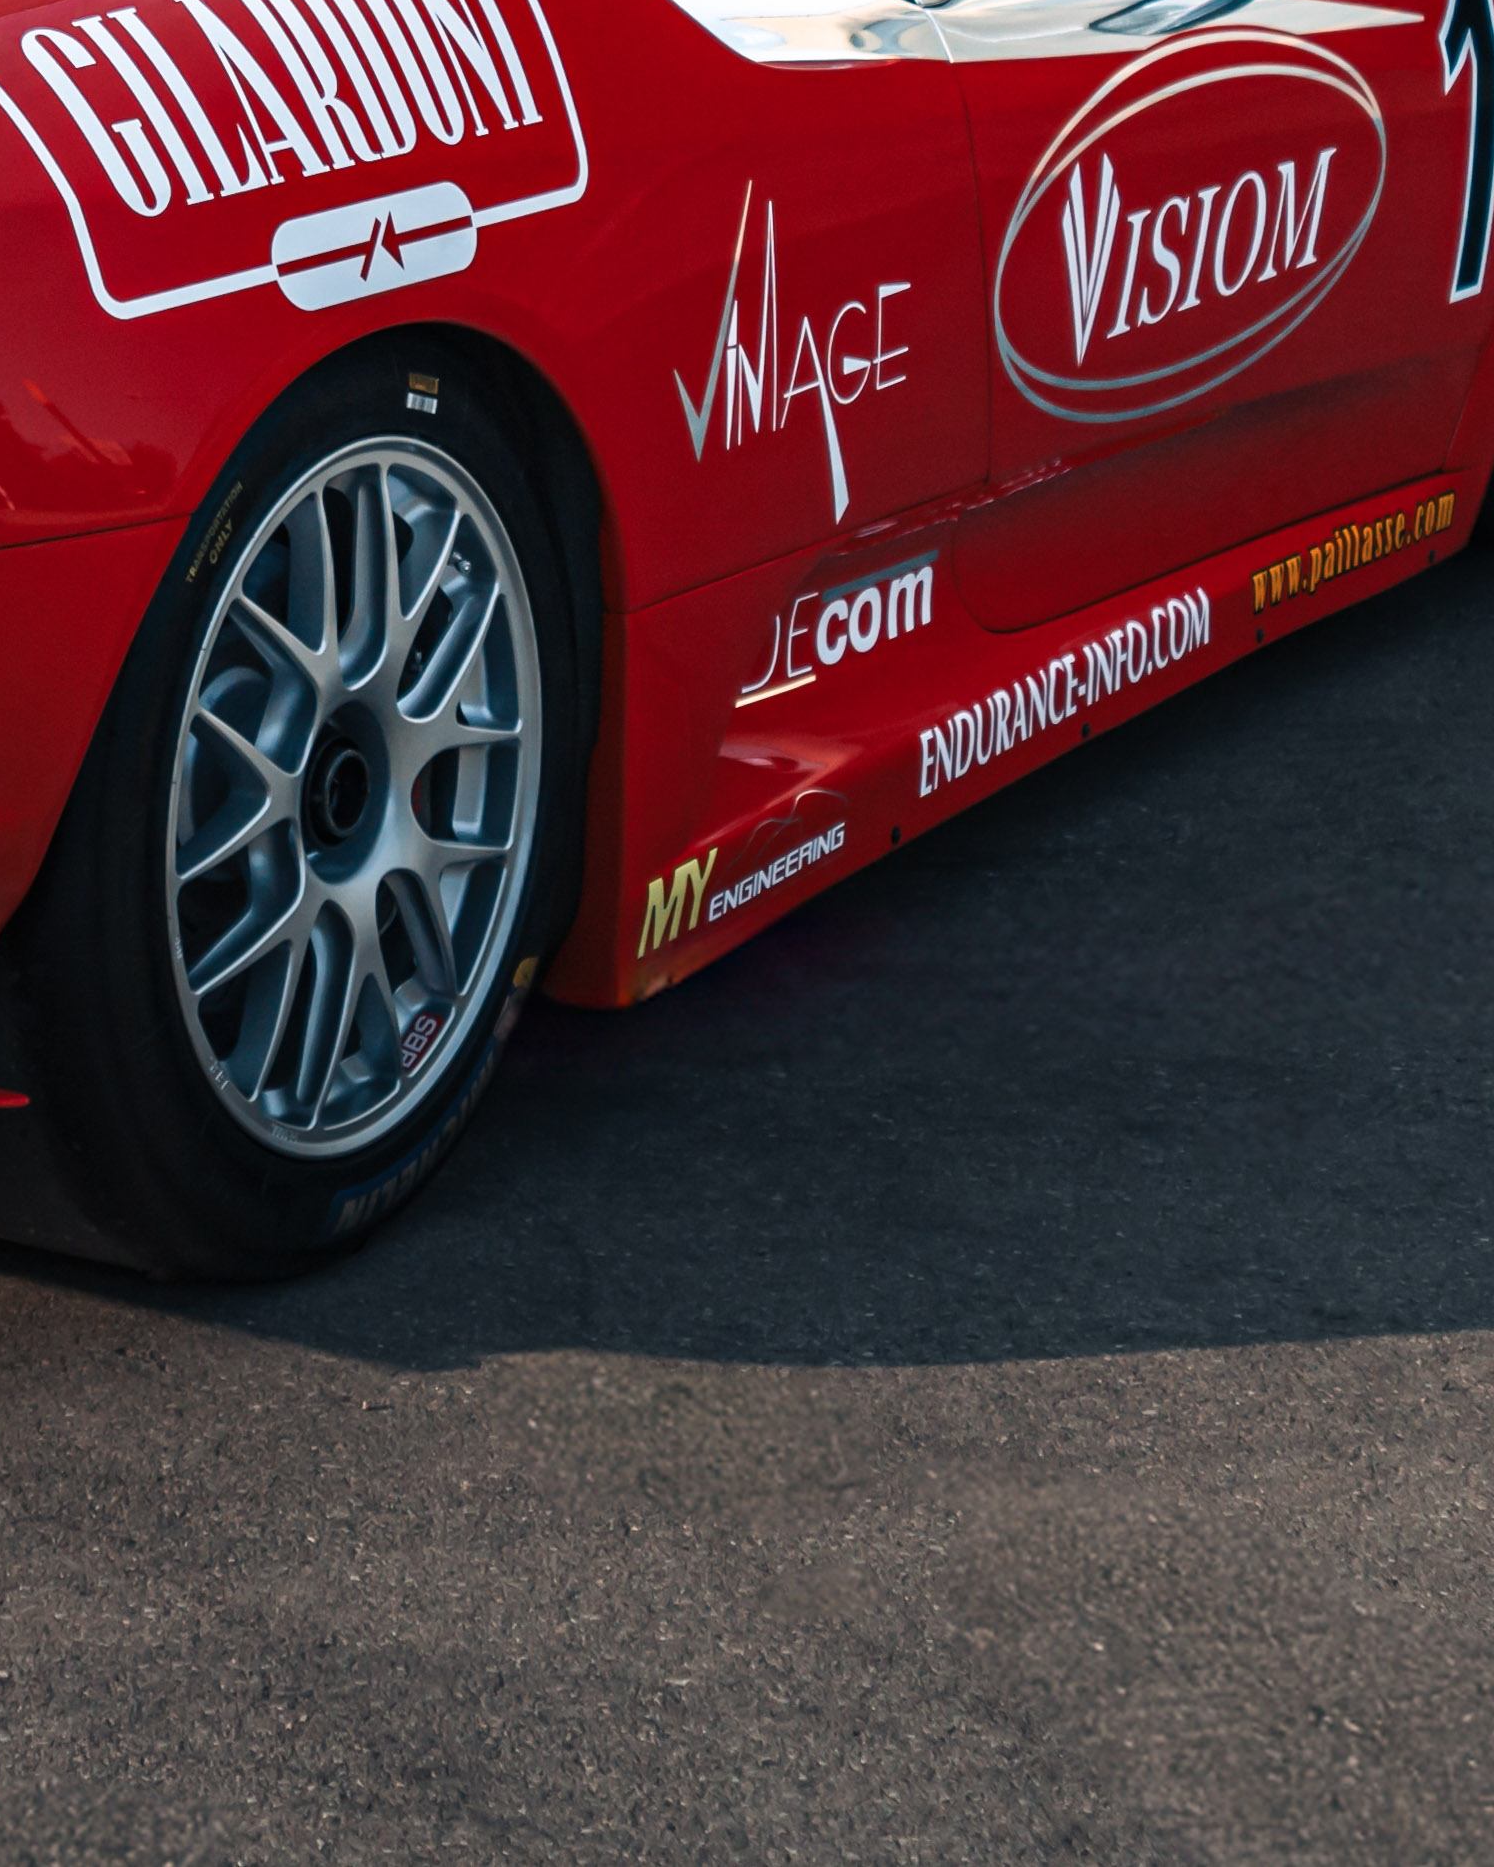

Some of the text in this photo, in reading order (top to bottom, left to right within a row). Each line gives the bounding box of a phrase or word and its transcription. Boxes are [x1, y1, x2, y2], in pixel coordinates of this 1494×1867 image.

[1062, 147, 1337, 367] VISIOM
[209, 518, 232, 564] ONLY
[1251, 490, 1455, 614] www.paillasse.com
[919, 587, 1210, 798] ENDURANCE-INFO.COM
[637, 822, 846, 960] MY ENGINEERING
